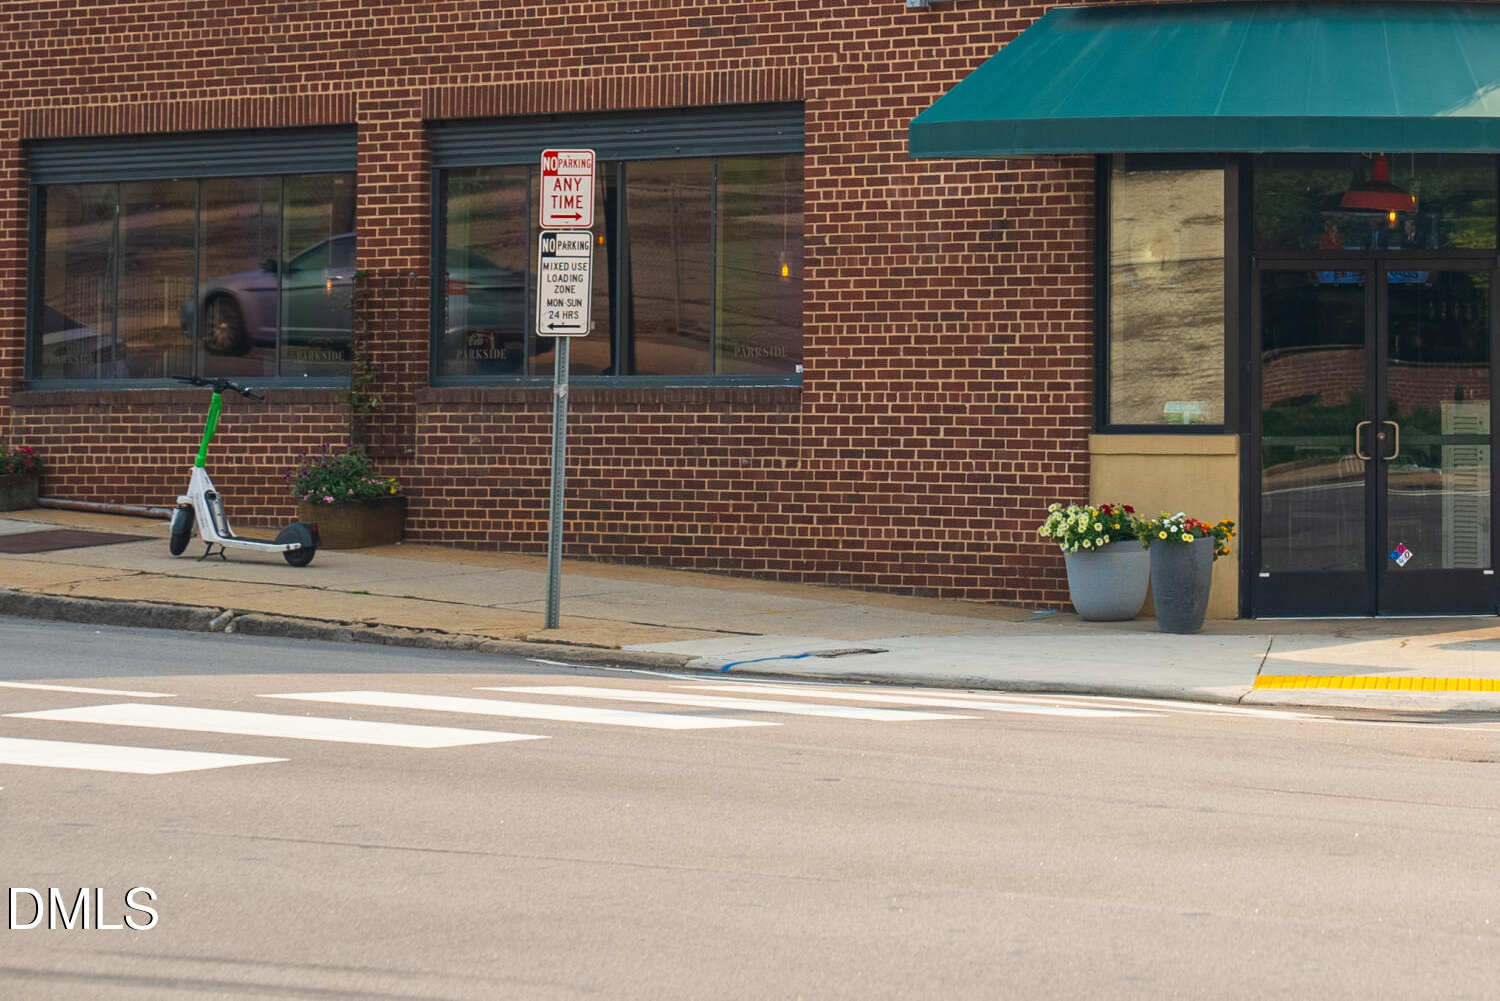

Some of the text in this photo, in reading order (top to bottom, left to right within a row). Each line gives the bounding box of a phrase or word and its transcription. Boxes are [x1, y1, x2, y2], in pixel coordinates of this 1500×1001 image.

[543, 156, 592, 172] NO PARKING
[553, 177, 583, 192] ANY
[551, 194, 584, 210] TIME
[542, 237, 590, 253] NO PARKING
[543, 262, 588, 271] MIXED USE
[546, 273, 584, 283] LOADING
[554, 284, 576, 294] ZONE
[548, 310, 579, 320] 24 HRS
